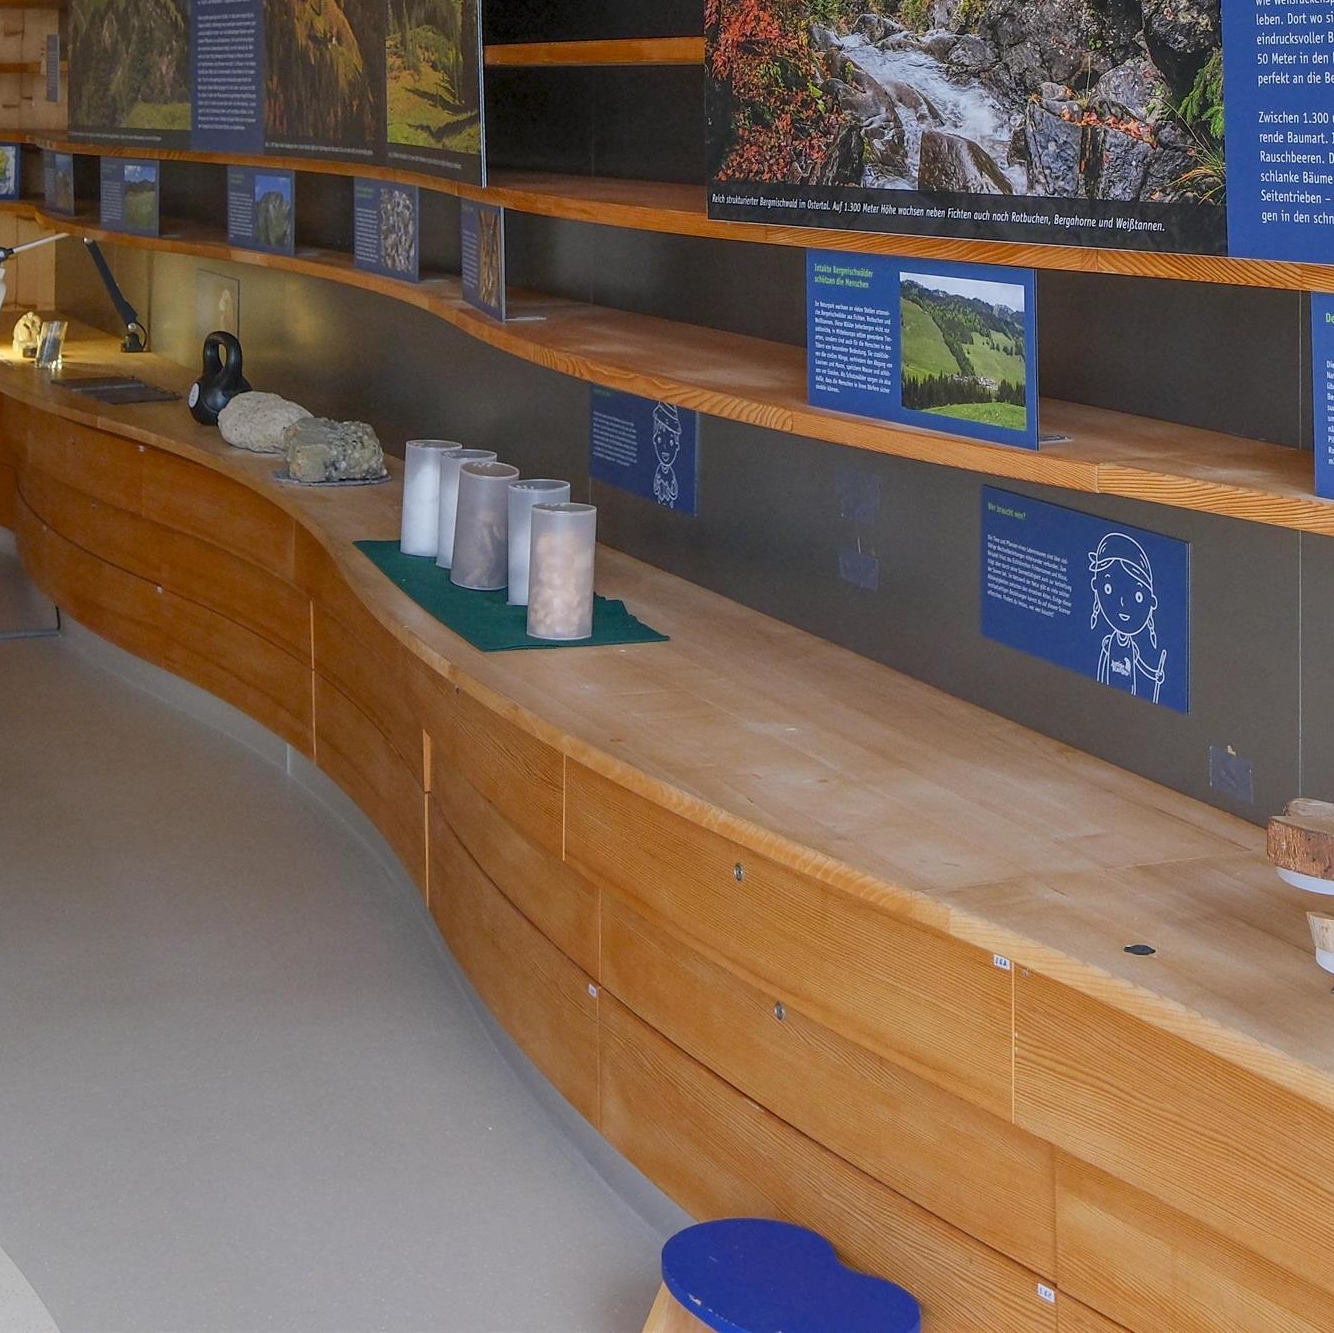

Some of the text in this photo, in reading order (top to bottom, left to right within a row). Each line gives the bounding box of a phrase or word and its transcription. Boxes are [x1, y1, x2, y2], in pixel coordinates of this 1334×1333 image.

[759, 196, 798, 208] Bergmischwald
[807, 199, 830, 210] Ostertal.
[831, 201, 843, 213] Auf
[844, 202, 861, 212] 1.300
[862, 203, 879, 213] Meter
[880, 204, 896, 214] Höhe
[897, 205, 924, 216] wachsen
[925, 206, 945, 217] neben
[947, 207, 972, 219] Fichten
[973, 210, 990, 220] auch
[992, 211, 1009, 221] noch
[1053, 214, 1096, 228] Bergahorne
[1098, 218, 1114, 228] und
[1116, 218, 1165, 232] Weißtannen.
